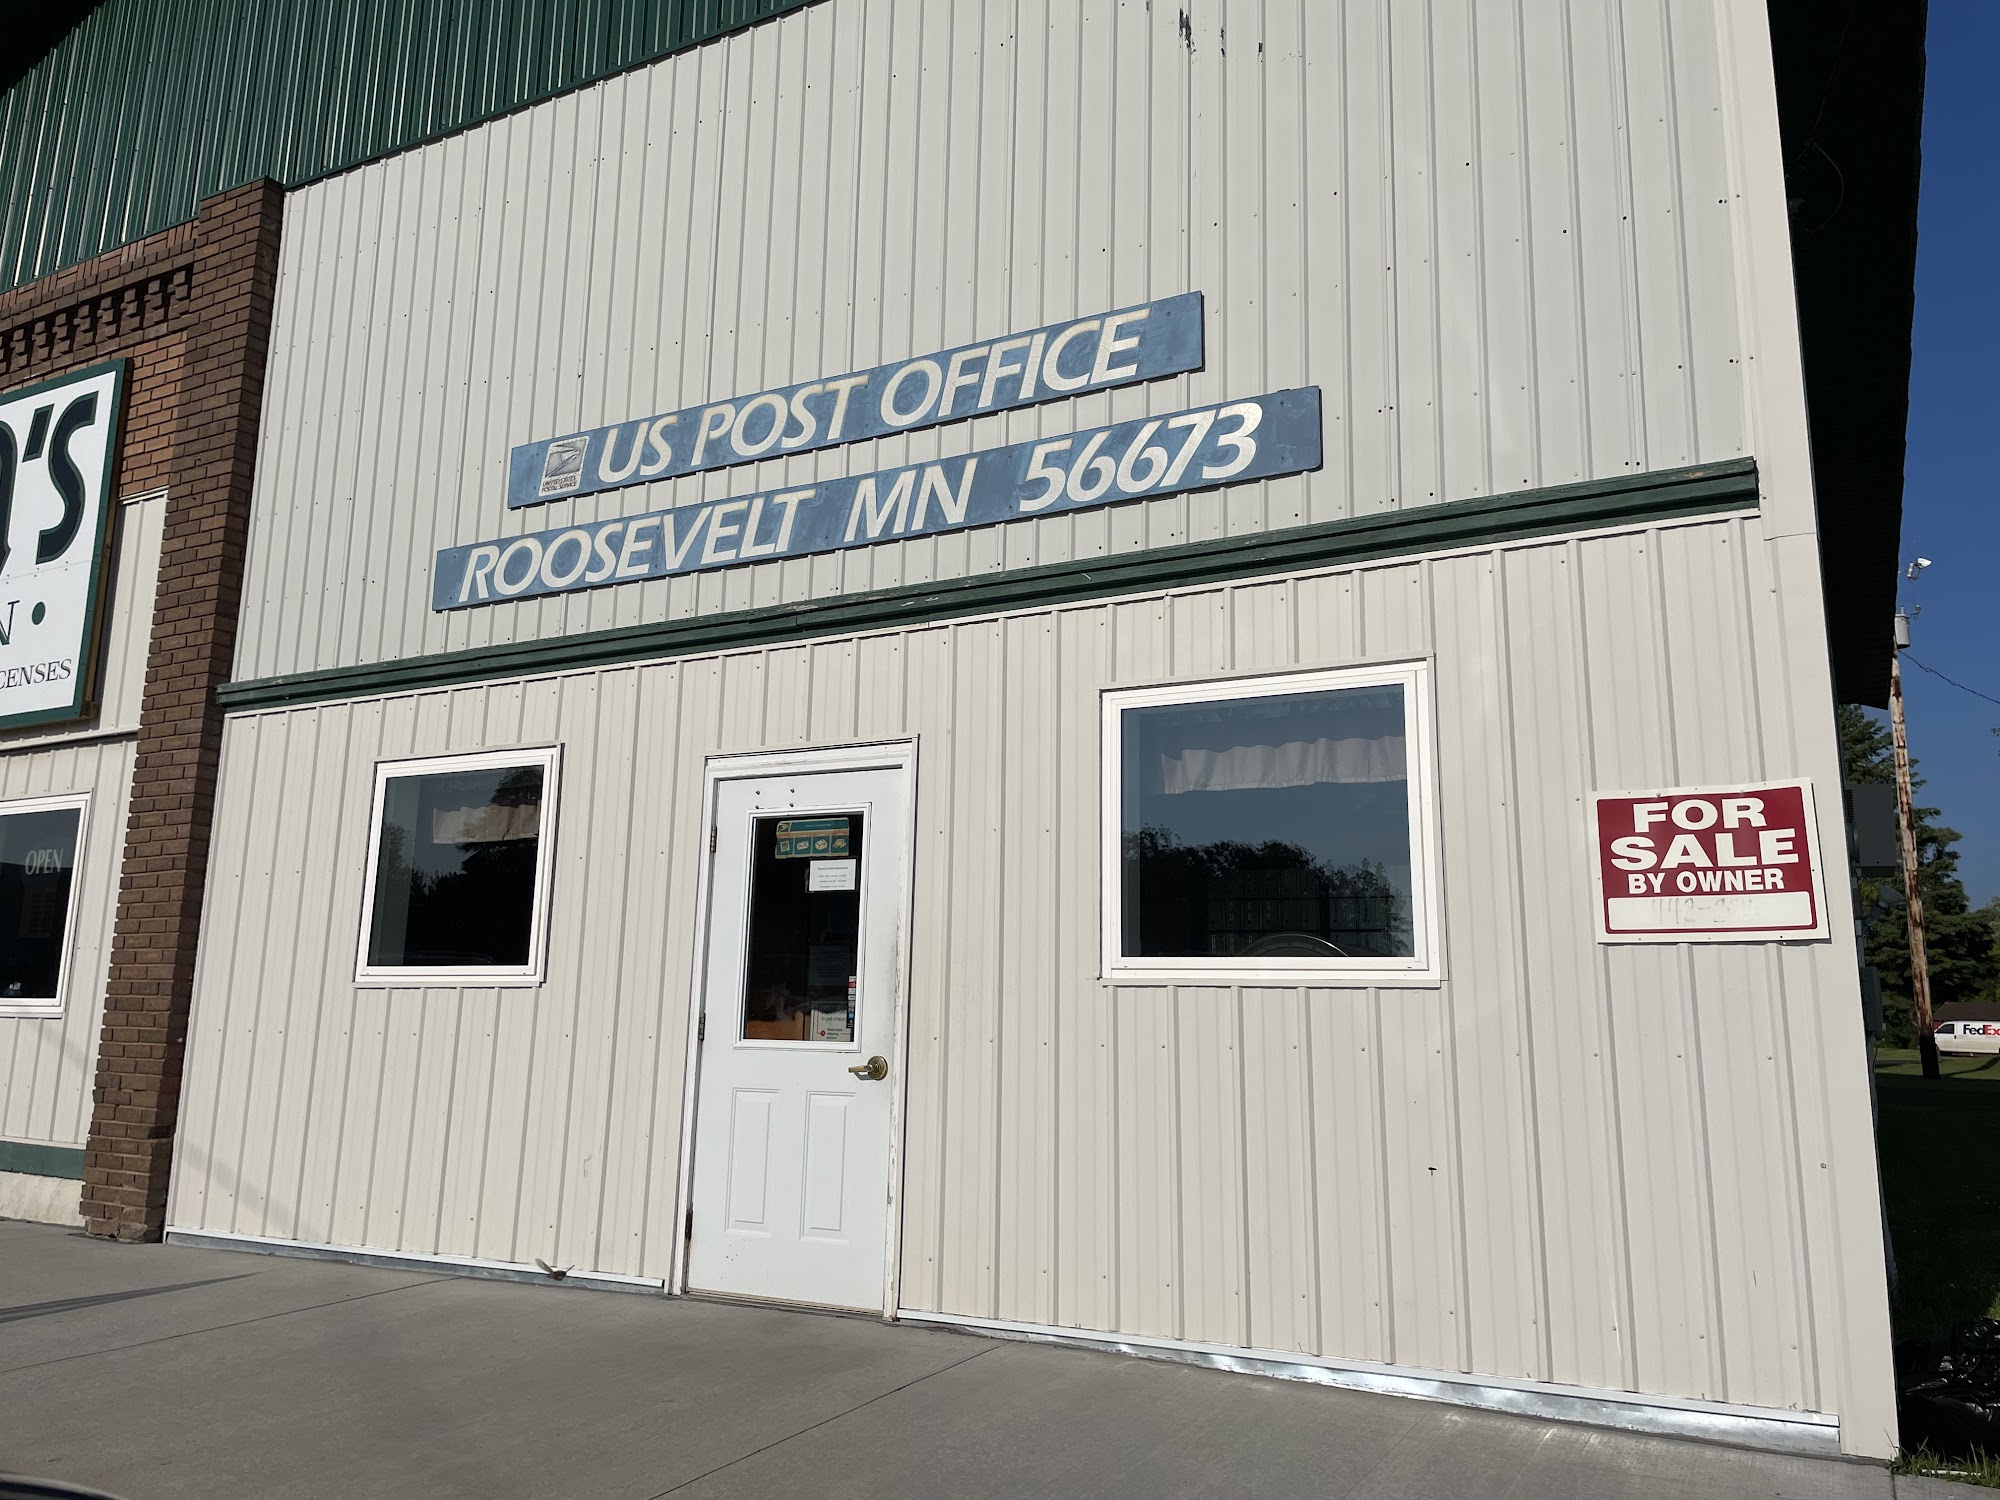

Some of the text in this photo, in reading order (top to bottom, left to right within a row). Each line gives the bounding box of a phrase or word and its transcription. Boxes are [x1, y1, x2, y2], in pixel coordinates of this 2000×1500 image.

[599, 307, 1151, 484] US POST OFFICE
[542, 479, 561, 487] UNITED
[458, 402, 1263, 602] ROOSEVELT MN 56673
[1633, 797, 1767, 833] FOR
[25, 848, 64, 876] OPEN
[1610, 828, 1799, 871] SALE
[1628, 868, 1785, 894] BY OWNER
[1963, 1023, 2000, 1036] FedEx
